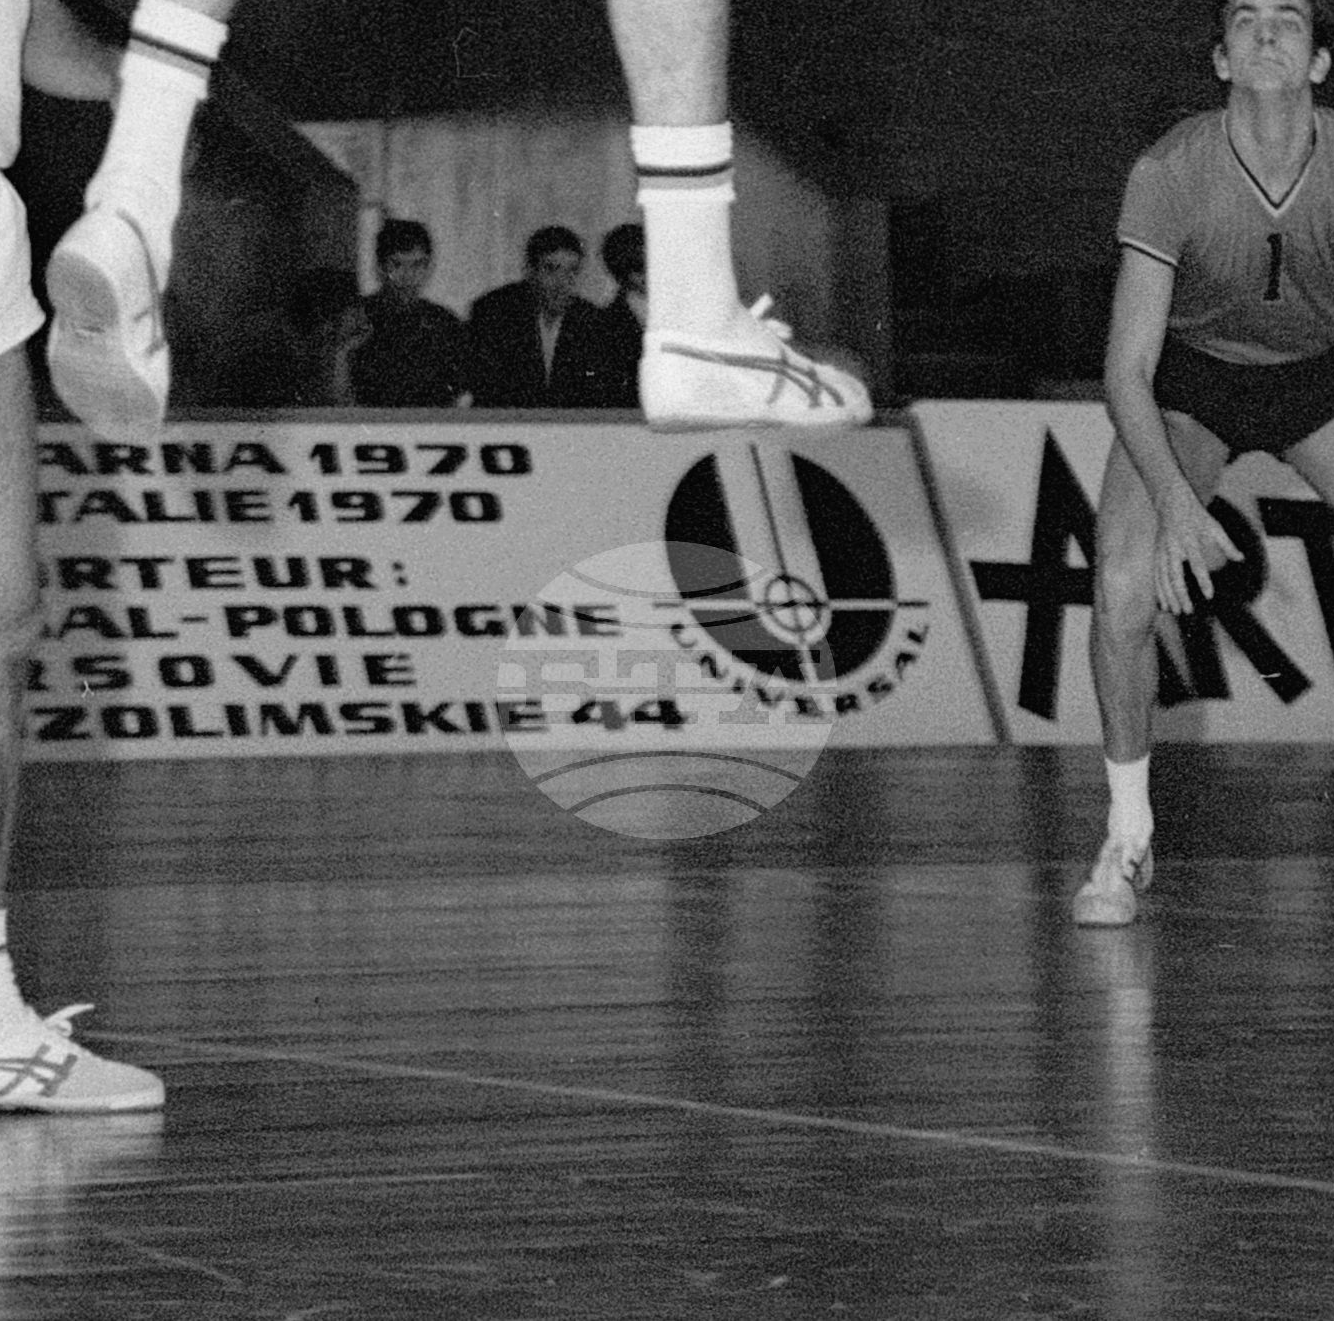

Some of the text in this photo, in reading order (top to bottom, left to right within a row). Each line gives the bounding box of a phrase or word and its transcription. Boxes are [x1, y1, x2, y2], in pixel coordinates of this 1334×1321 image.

[1262, 232, 1283, 302] 1
[35, 441, 288, 478] ARNA
[310, 442, 536, 476] 1970
[35, 488, 274, 526] TALIE
[288, 488, 505, 524] 1970
[37, 553, 411, 592] RTEUR:
[669, 622, 930, 719] UNIVERSAL
[569, 698, 691, 731] 44
